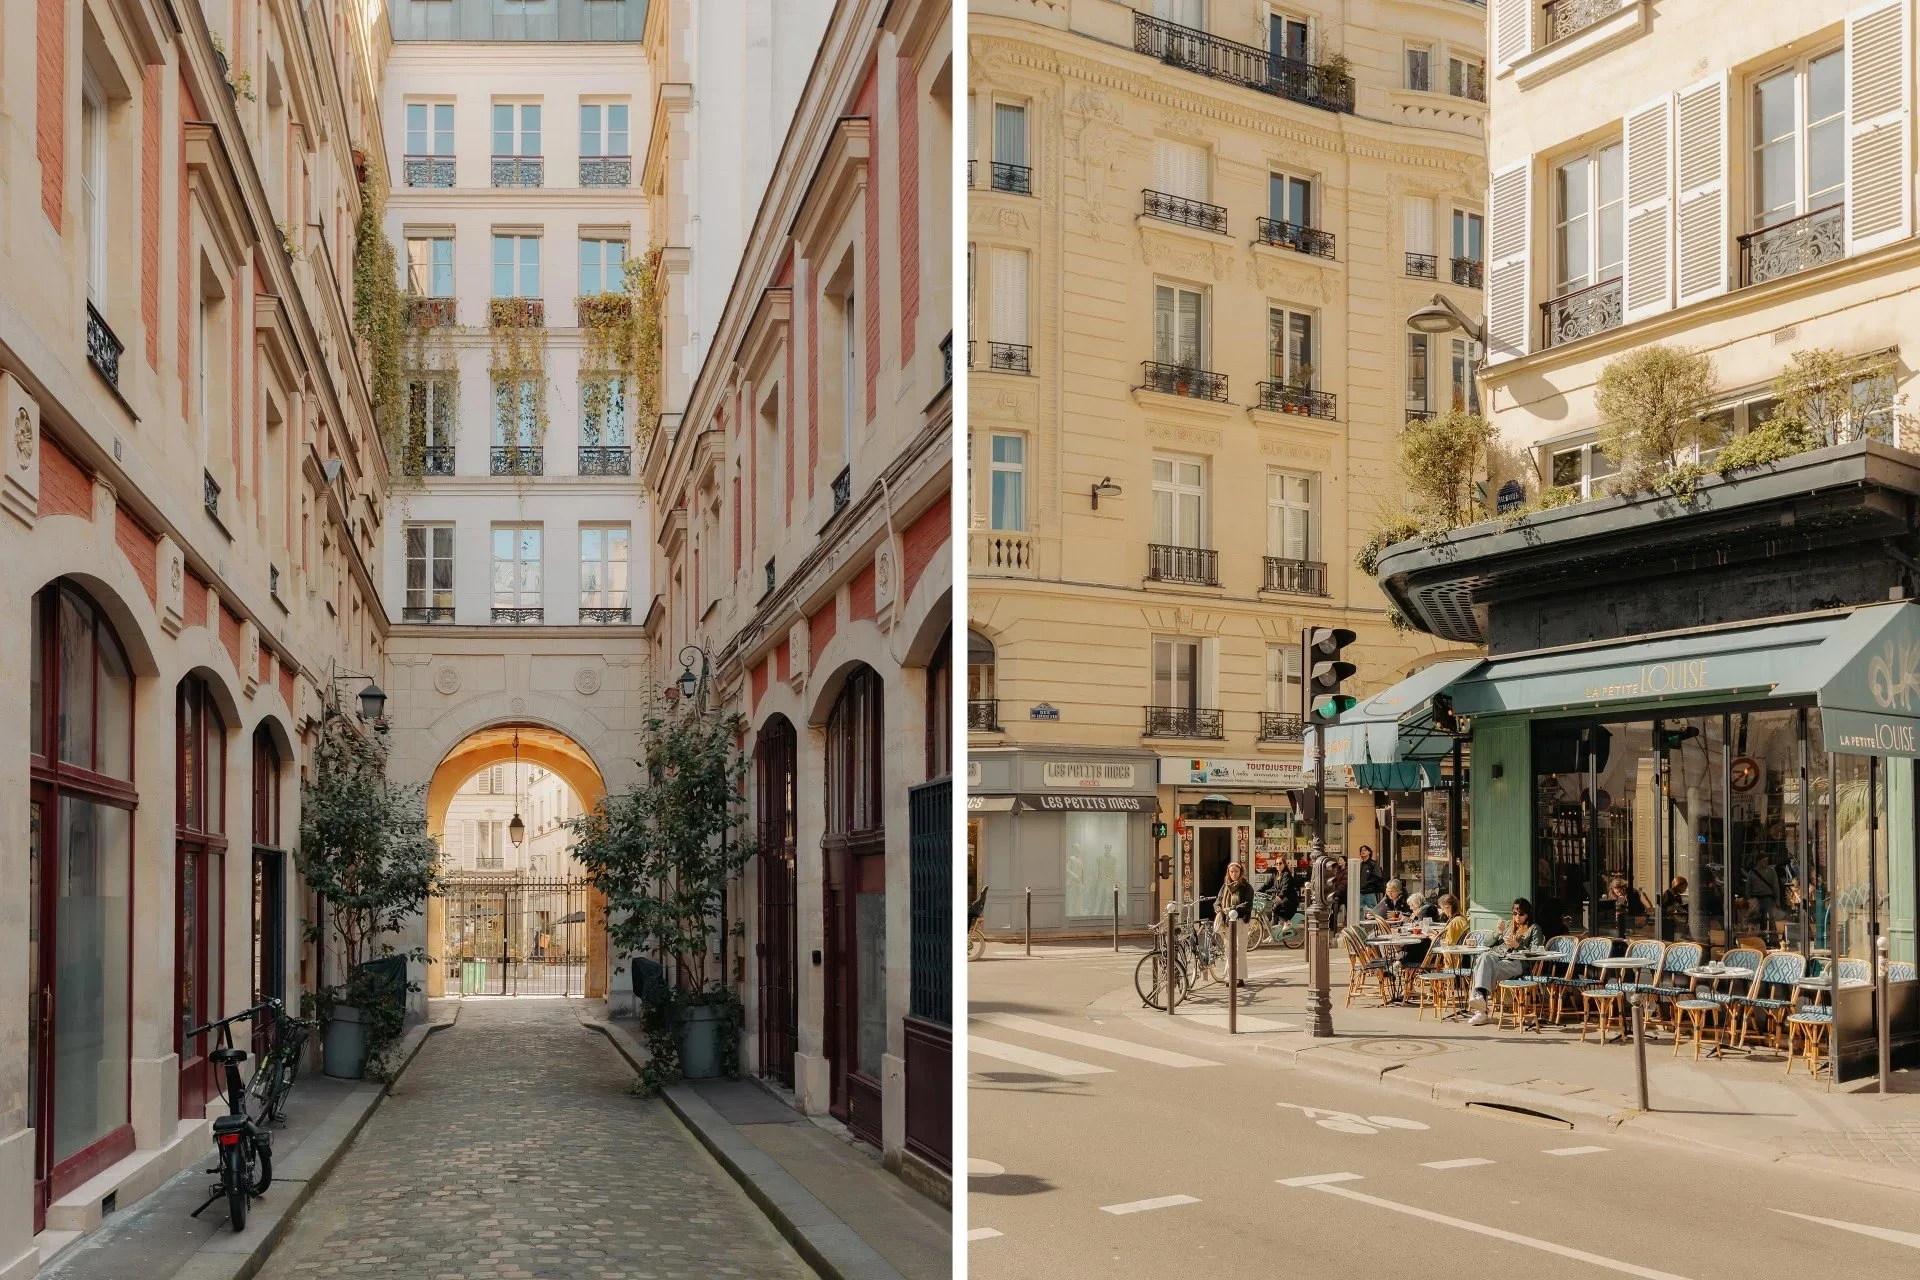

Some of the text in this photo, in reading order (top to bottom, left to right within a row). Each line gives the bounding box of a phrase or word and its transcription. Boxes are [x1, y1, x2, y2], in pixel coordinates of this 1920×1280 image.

[1584, 660, 1709, 698] LA PETITE LOUISE
[1839, 723, 1916, 752] LA PETITE LOUISE
[1048, 764, 1130, 780] LES PETITS MECS
[1247, 763, 1302, 772] TOUTOJUSTEPR
[1040, 796, 1140, 810] LES PETITS MECS
